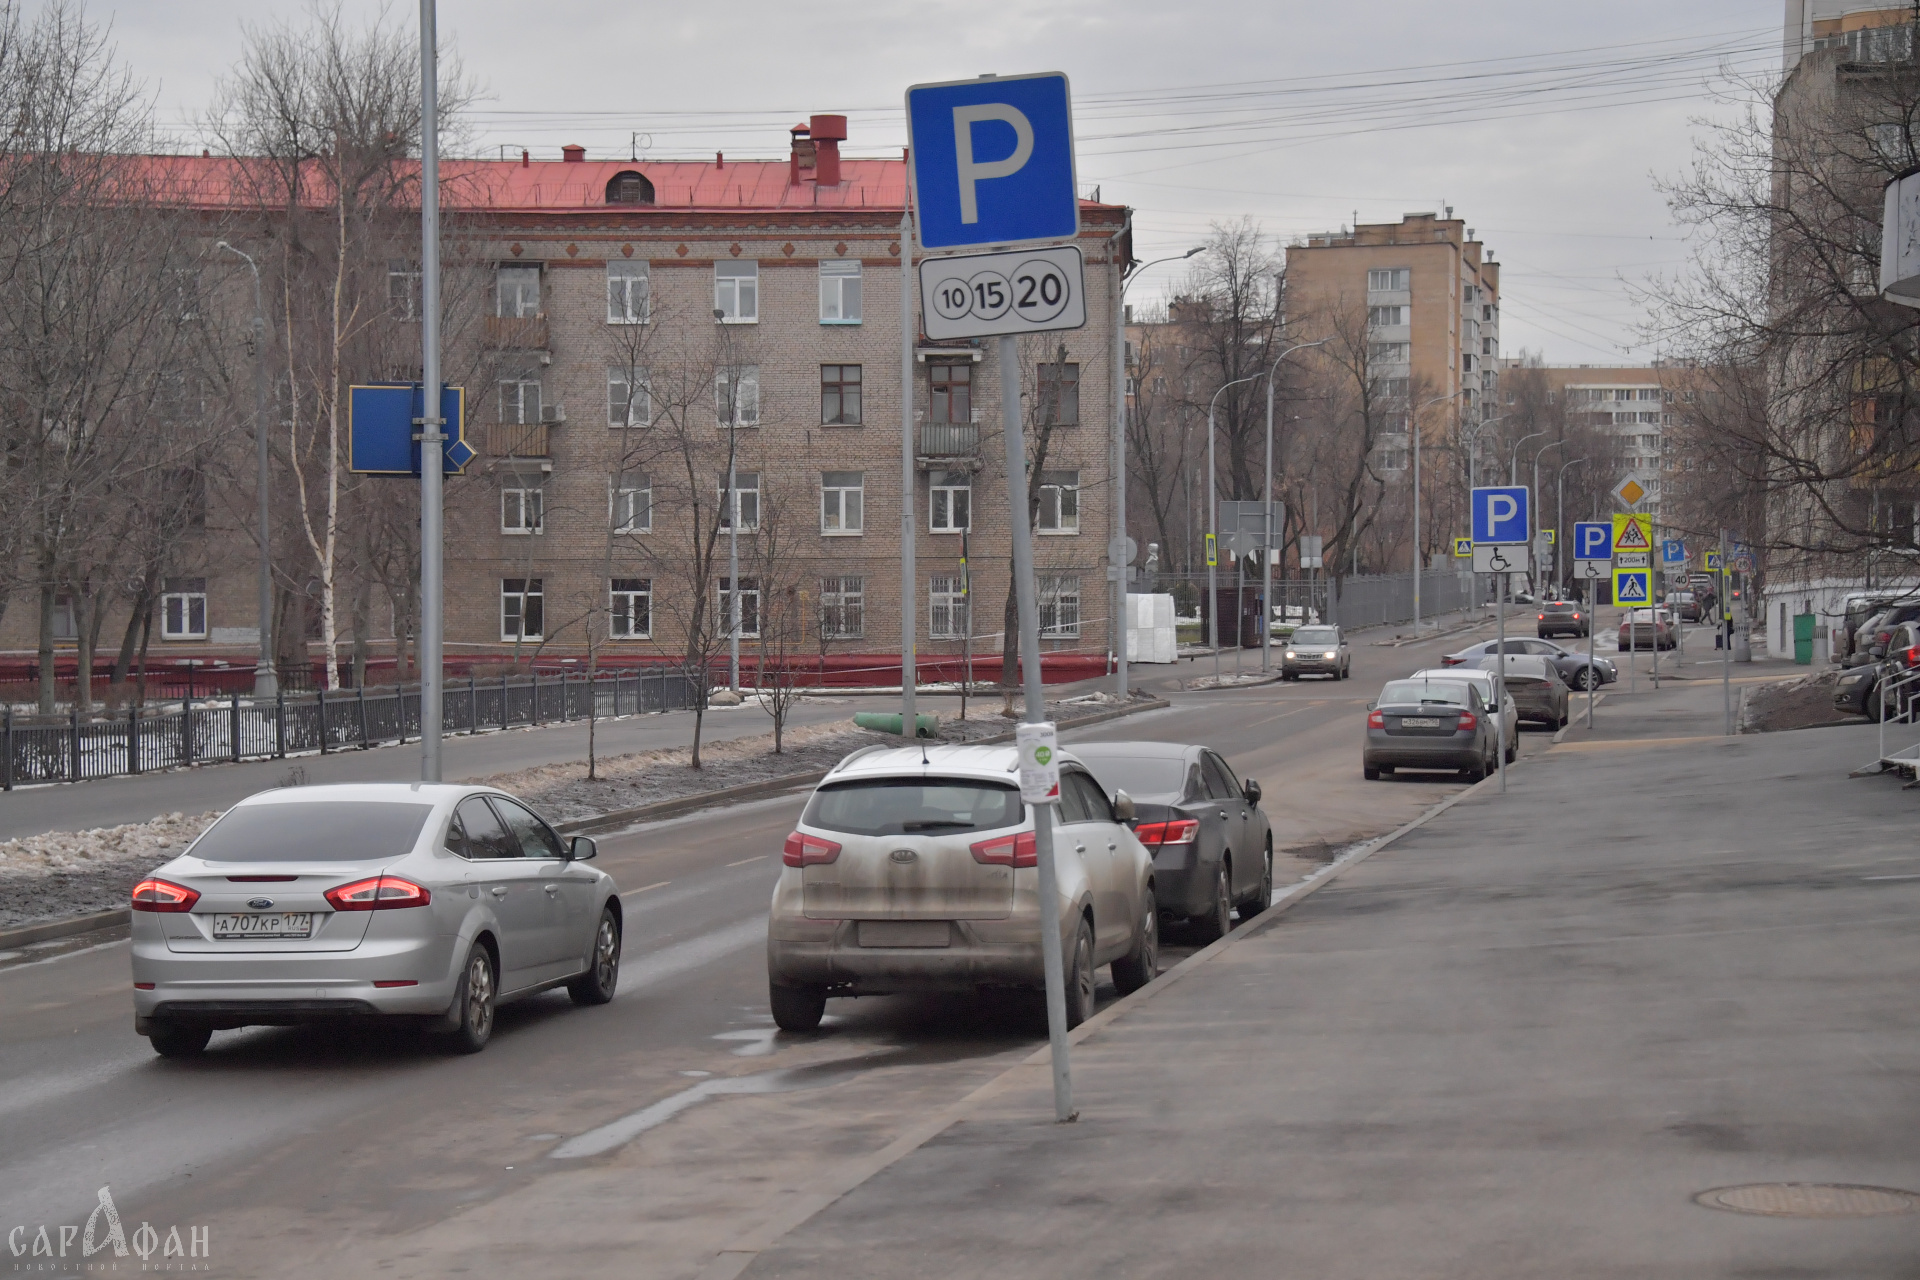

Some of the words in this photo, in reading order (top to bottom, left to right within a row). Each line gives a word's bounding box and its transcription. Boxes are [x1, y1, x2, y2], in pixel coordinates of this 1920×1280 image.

[952, 103, 1034, 224] P
[942, 288, 965, 309] 10
[975, 281, 1004, 309] 15
[1017, 273, 1061, 308] 20
[1487, 494, 1518, 537] P
[1584, 527, 1606, 555] P
[1667, 542, 1680, 560] P
[1675, 575, 1687, 584] 40
[284, 914, 306, 926] 177
